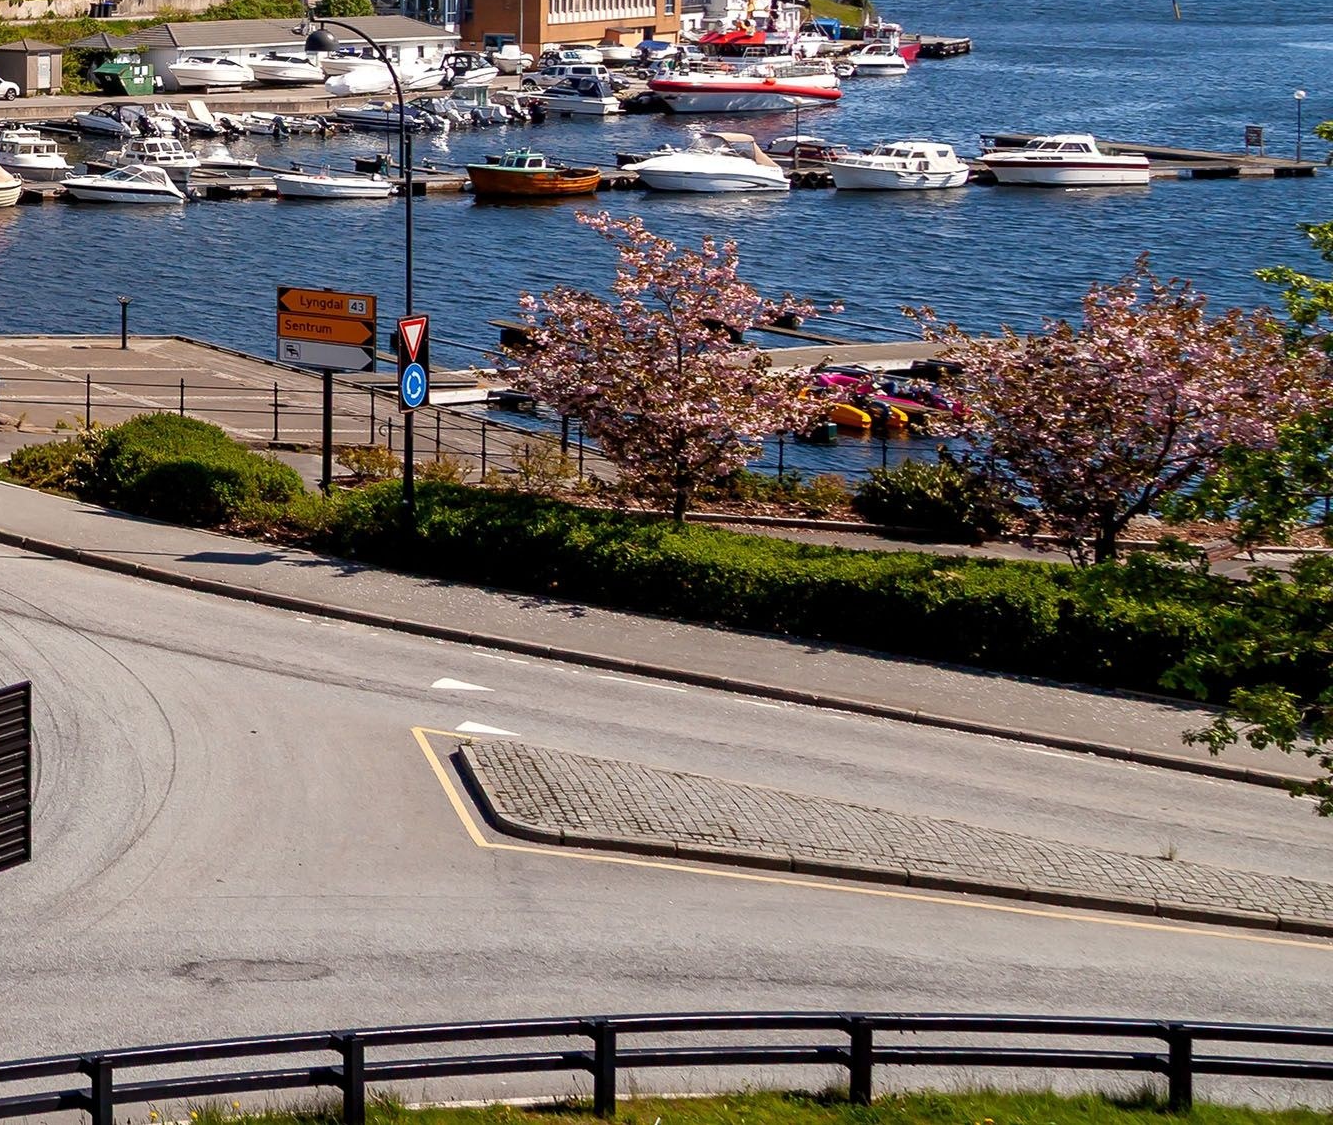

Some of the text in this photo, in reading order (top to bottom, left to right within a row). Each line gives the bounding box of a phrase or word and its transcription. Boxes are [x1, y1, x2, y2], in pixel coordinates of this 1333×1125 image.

[300, 296, 364, 312] Lyngdal 43
[285, 320, 332, 334] Sentrum
